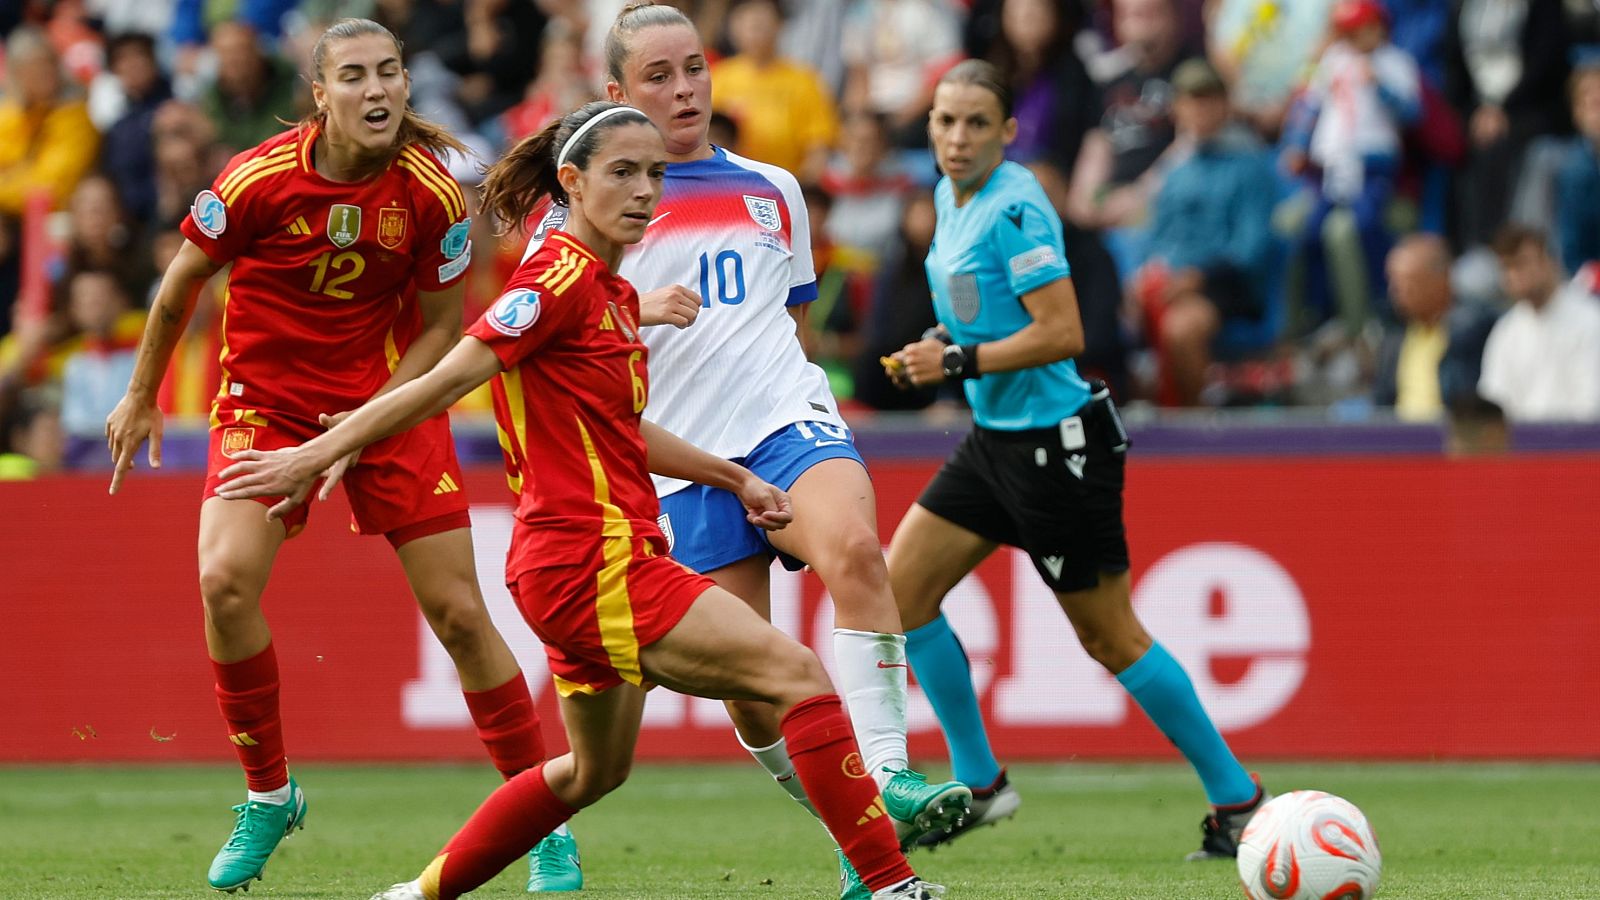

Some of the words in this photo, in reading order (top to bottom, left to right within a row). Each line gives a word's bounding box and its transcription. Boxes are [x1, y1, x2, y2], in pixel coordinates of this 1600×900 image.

[308, 251, 366, 300] 12
[699, 250, 746, 308] 10
[628, 350, 646, 414] 6
